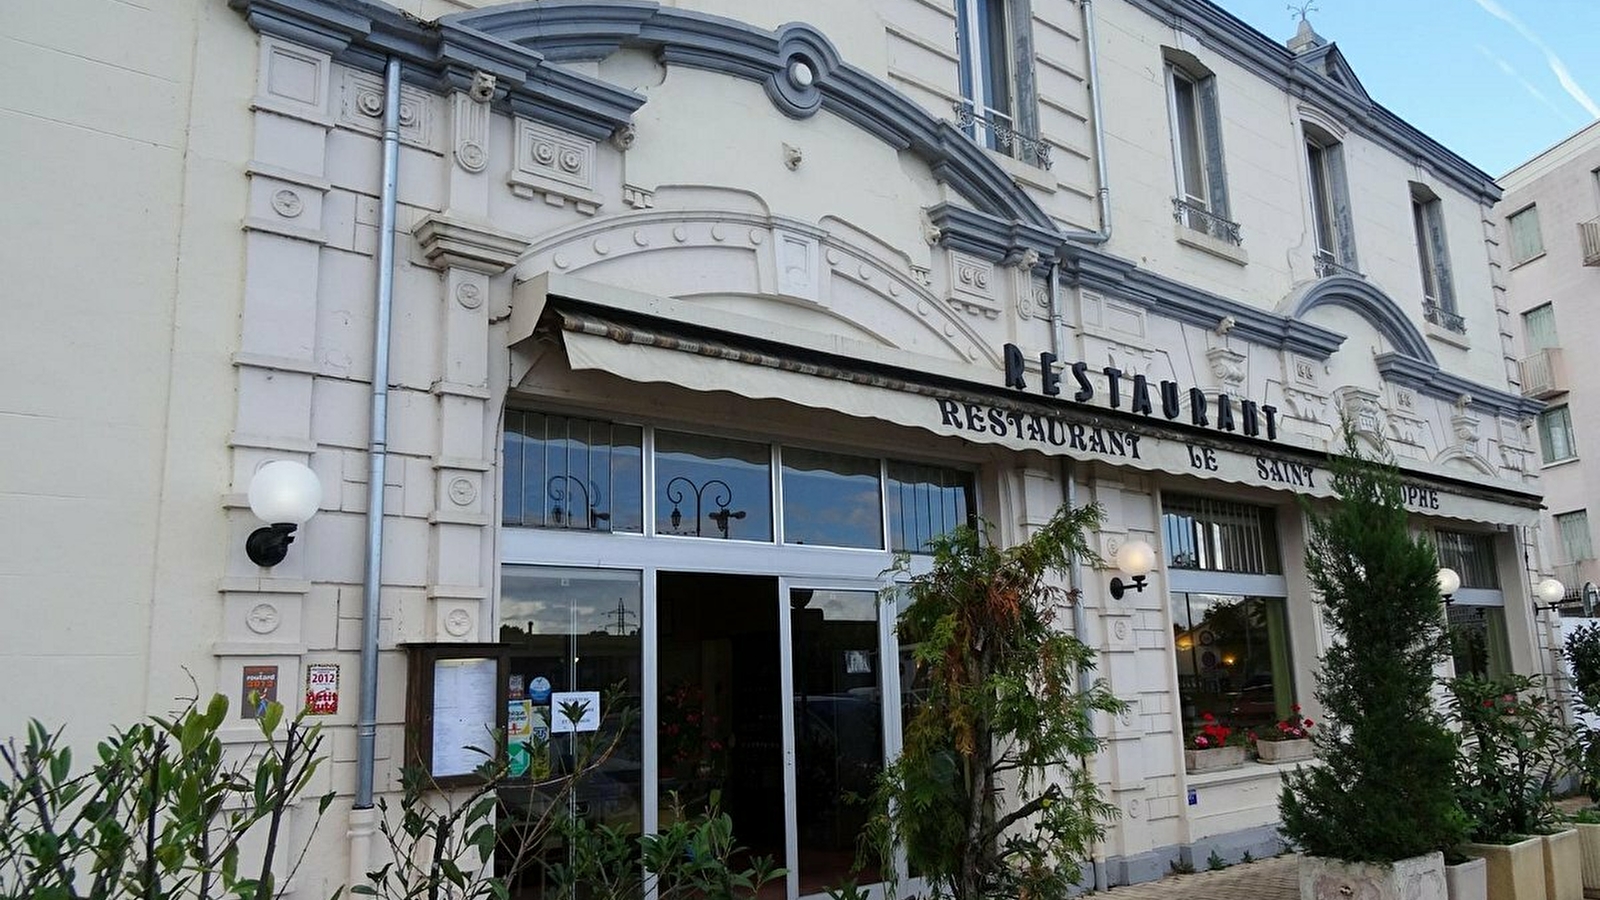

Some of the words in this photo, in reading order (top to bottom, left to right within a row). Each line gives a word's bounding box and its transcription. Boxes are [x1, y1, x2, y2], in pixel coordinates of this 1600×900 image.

[1004, 343, 1278, 441] RESTAURANT
[936, 398, 1141, 460] RESTAURANT
[1187, 444, 1218, 472] LE
[1256, 457, 1315, 488] SAINT
[312, 674, 335, 683] 2012
